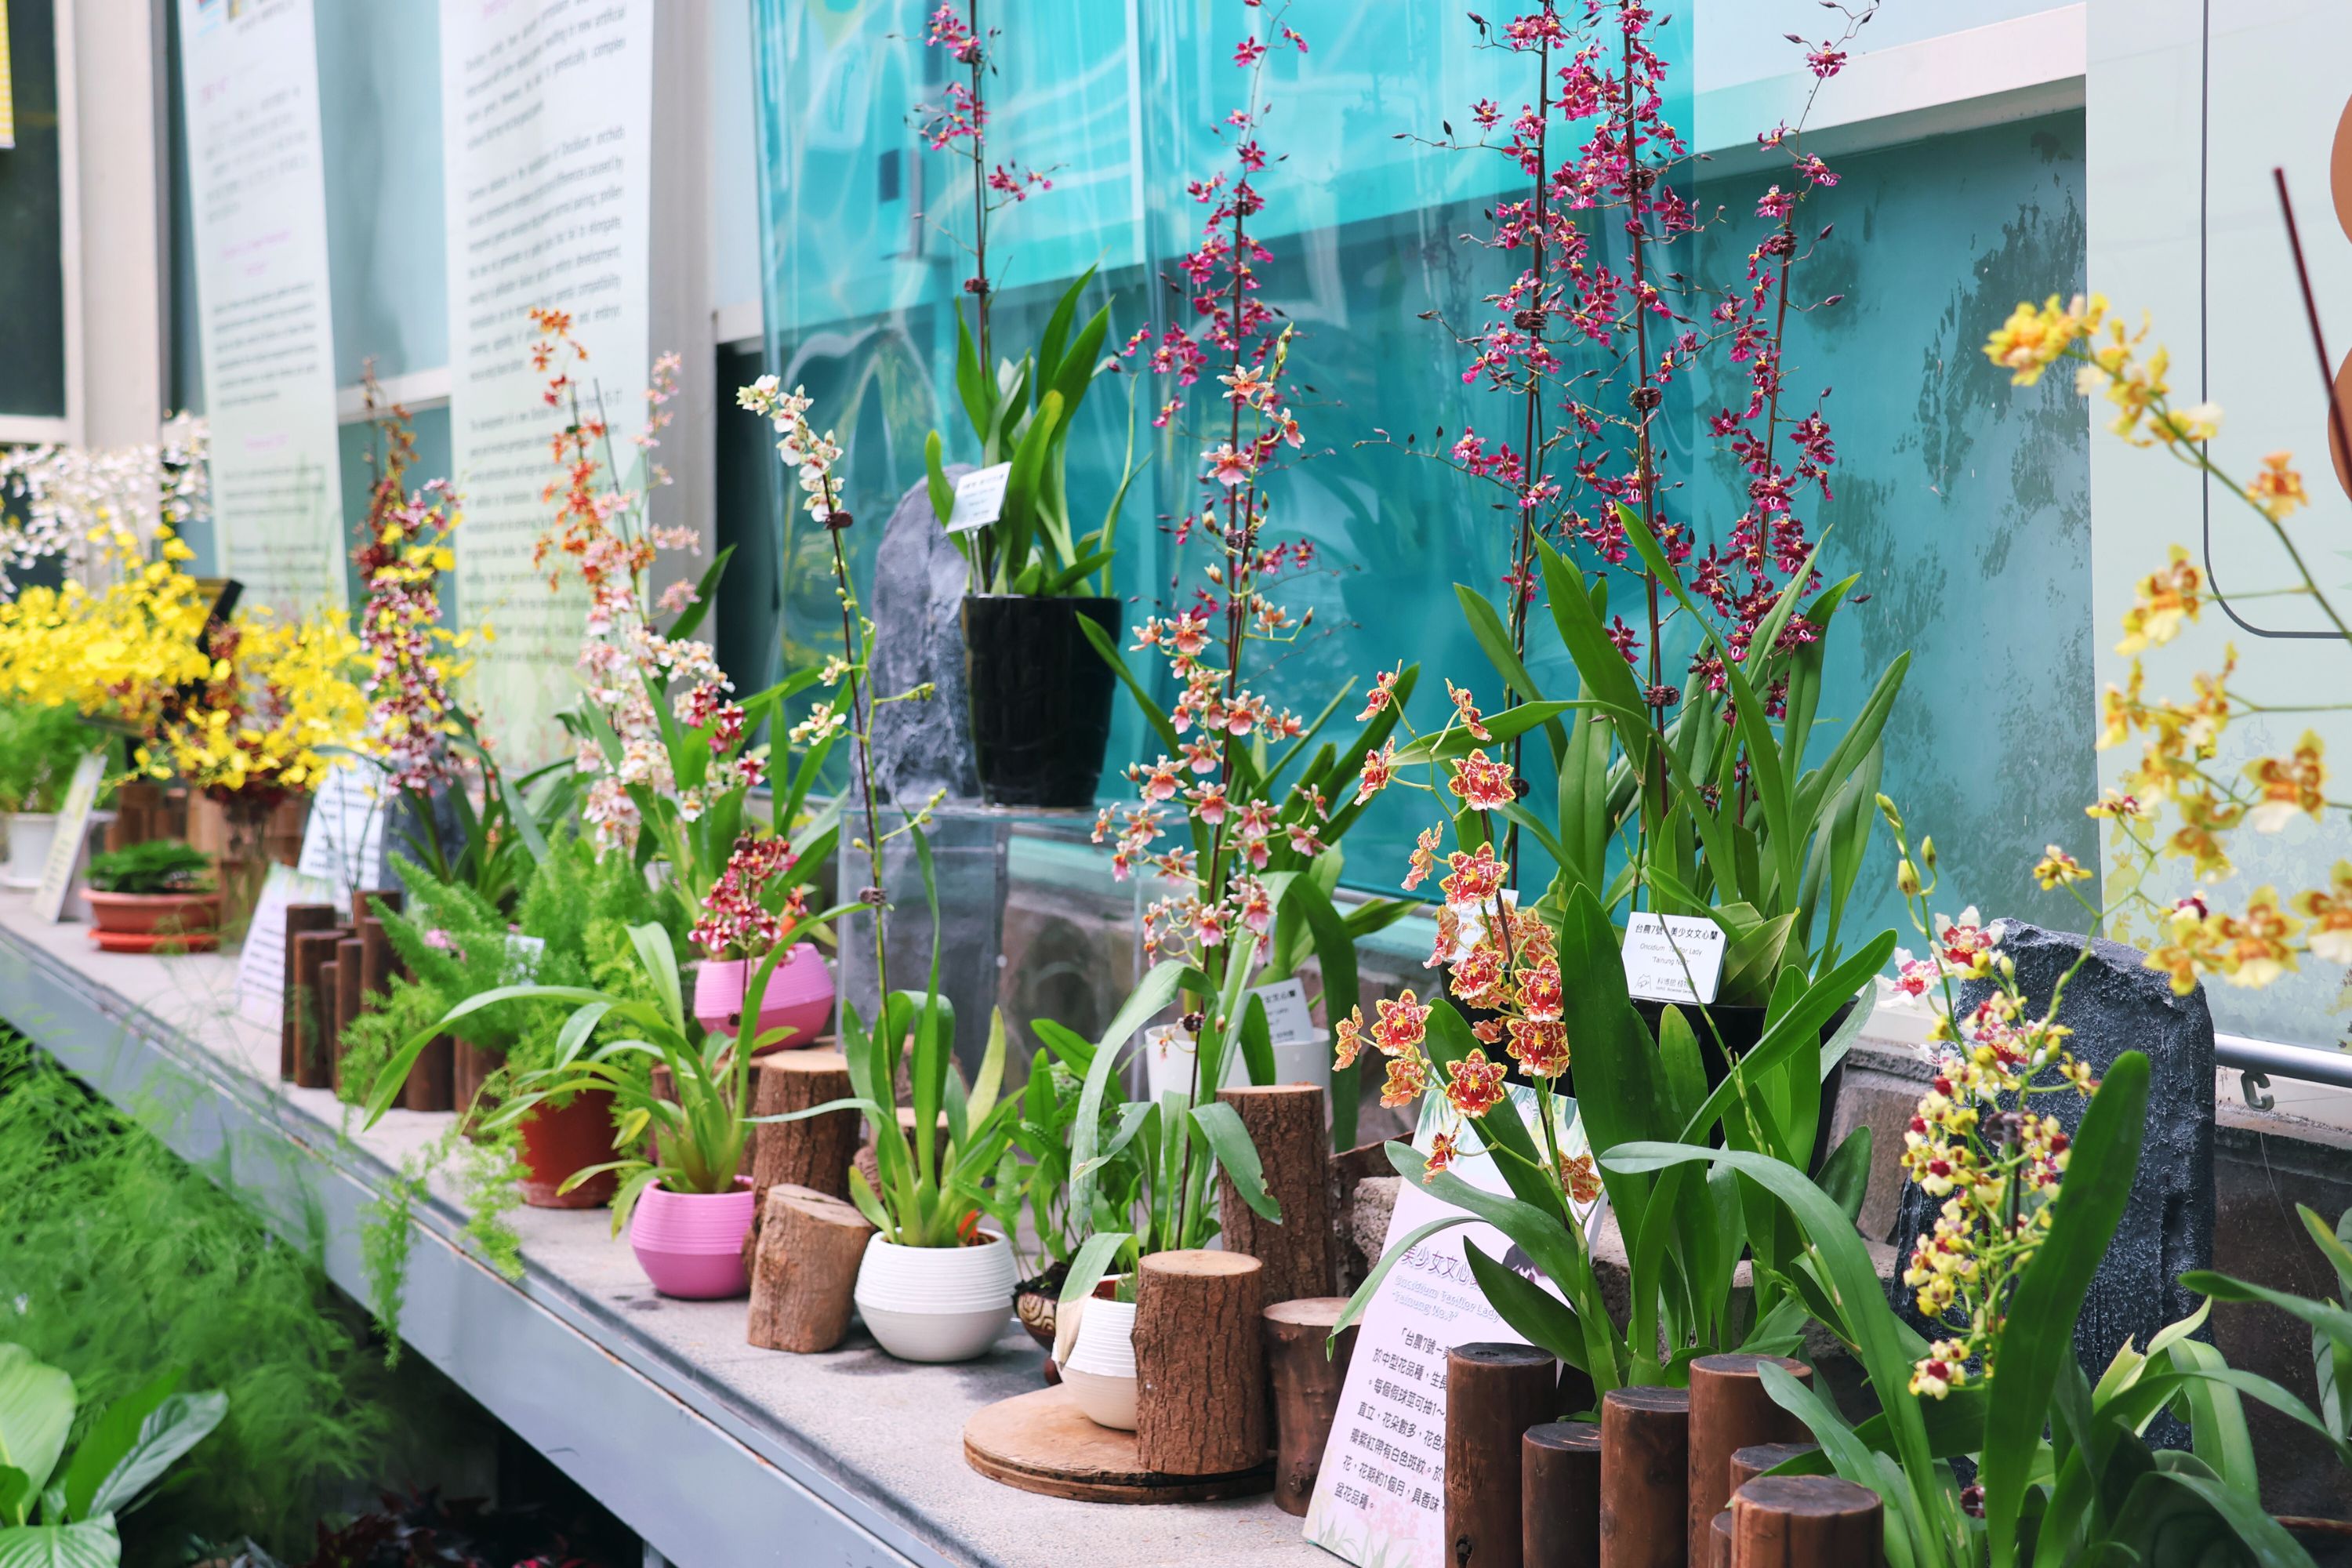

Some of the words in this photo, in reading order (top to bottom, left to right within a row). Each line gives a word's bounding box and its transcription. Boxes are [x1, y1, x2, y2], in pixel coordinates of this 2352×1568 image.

[1671, 927, 1718, 940] 美少女文心蘭
[1395, 1275, 1439, 1299] Oncidium
[1477, 1304, 1501, 1323] Lady
